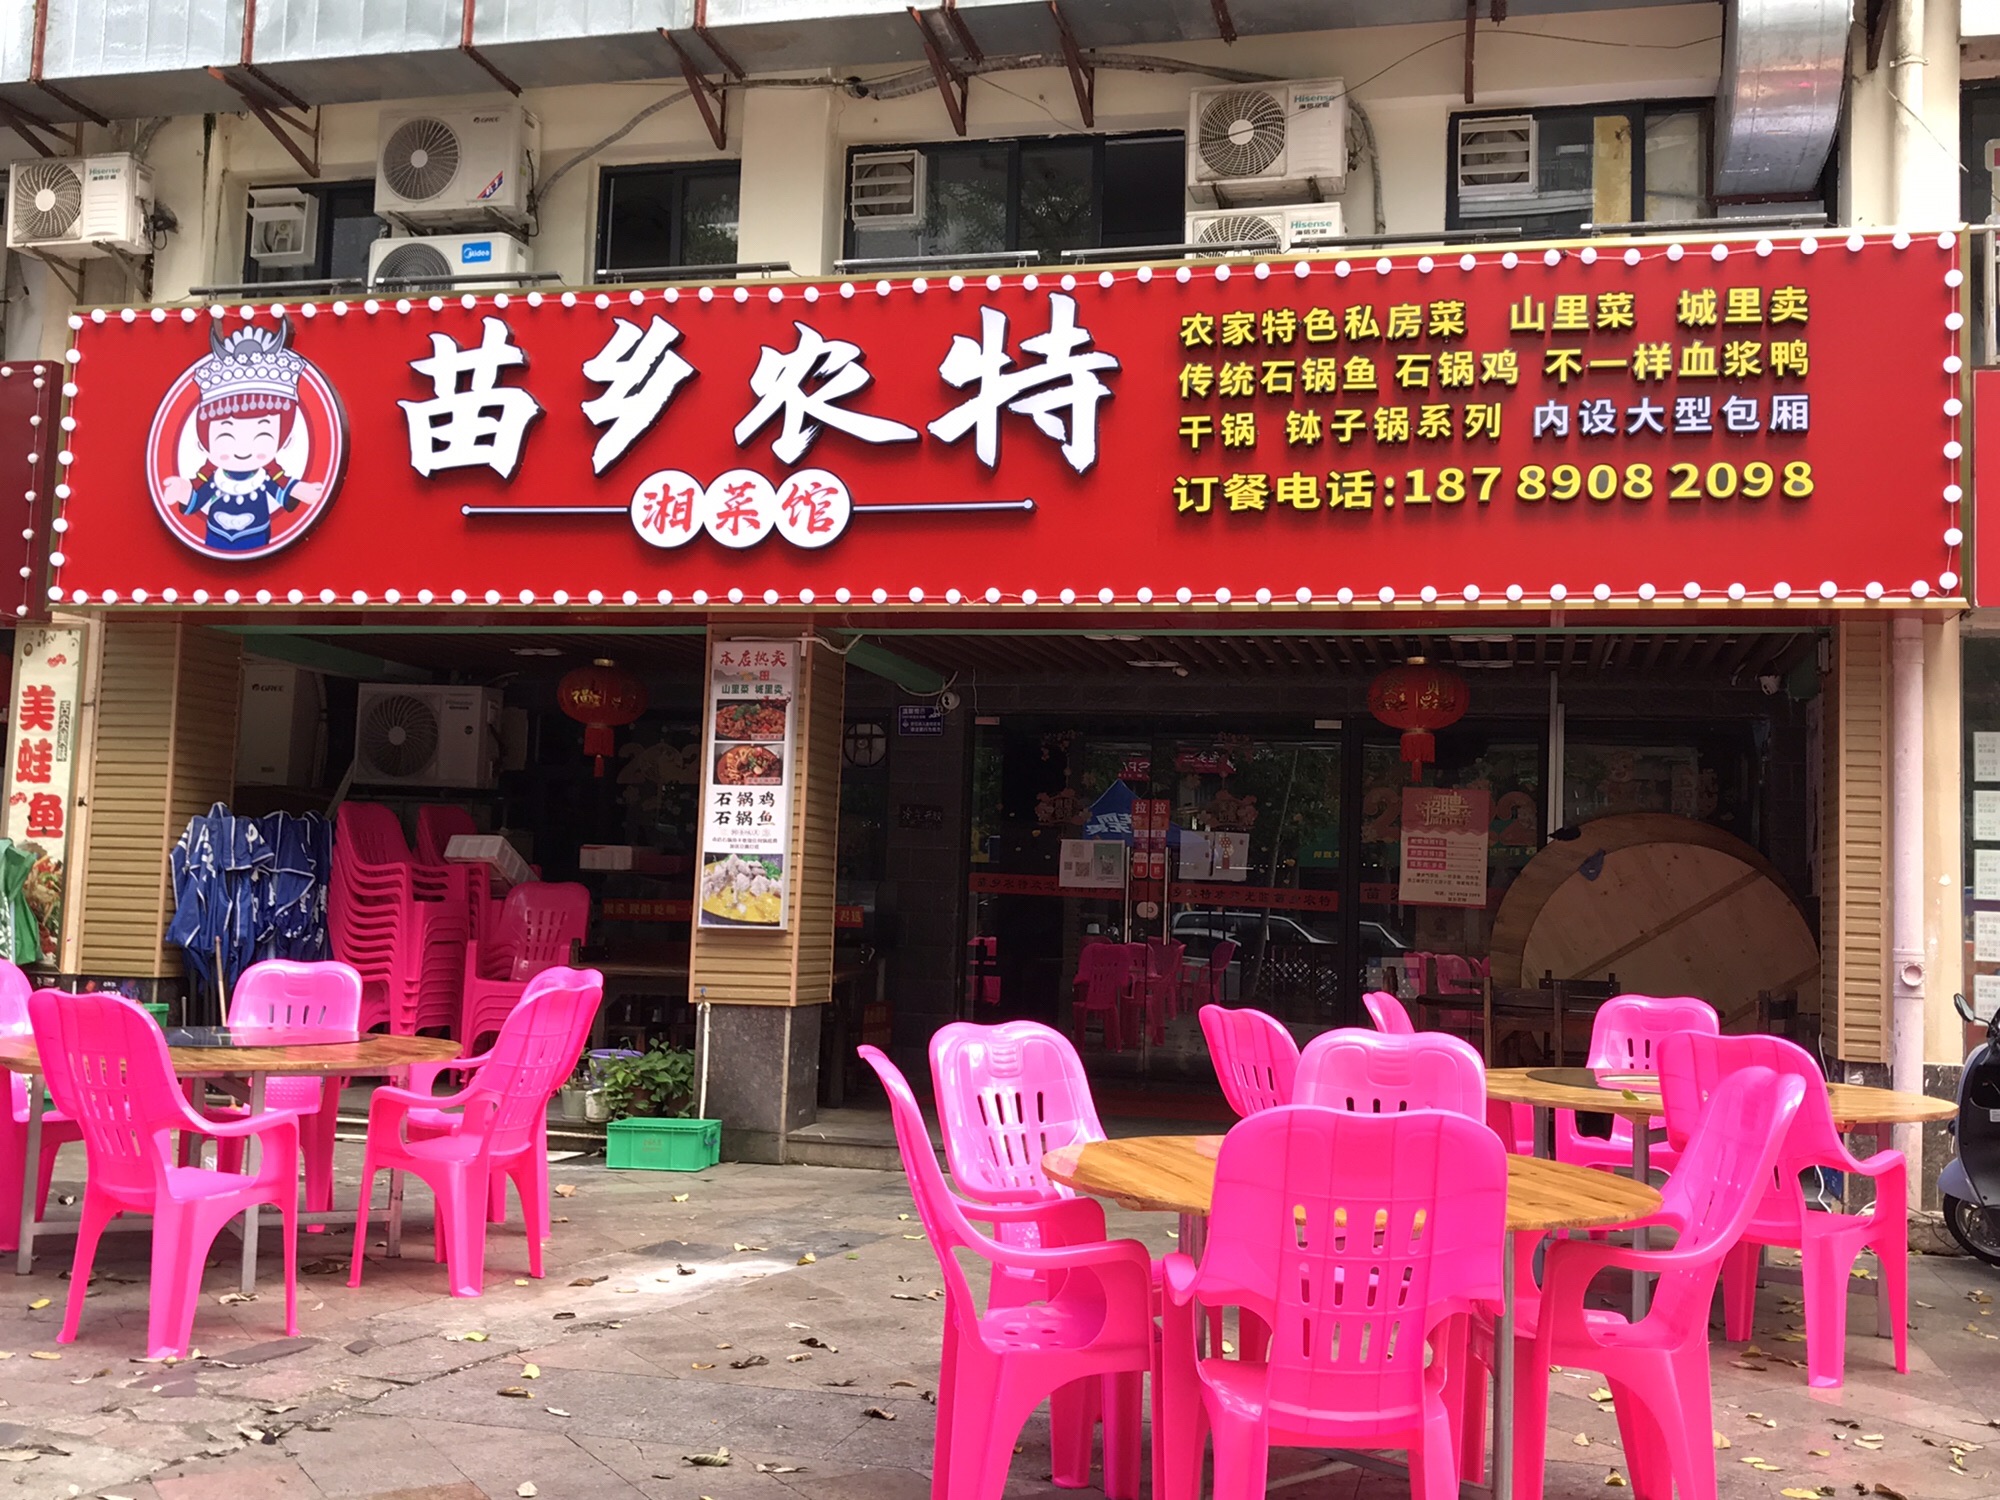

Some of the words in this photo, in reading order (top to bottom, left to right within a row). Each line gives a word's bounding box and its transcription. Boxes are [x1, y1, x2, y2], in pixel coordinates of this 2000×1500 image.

[1294, 94, 1335, 103] Hisense
[1290, 220, 1332, 229] Hisense
[467, 248, 490, 259] Midea
[1180, 300, 1465, 347] 农家特色私房菜
[1510, 292, 1634, 331] 山里菜
[1678, 286, 1809, 326] 城里卖
[1178, 355, 1378, 397] 传统石锅鱼
[1395, 349, 1519, 388] 石锅鸡
[1544, 339, 1810, 383] 不一样血浆鸭
[397, 292, 1121, 479] 苗乡农特
[1178, 412, 1256, 449] 干锅
[1285, 402, 1502, 445] 钵子锅系列
[1533, 394, 1810, 437] 内设大型包厢
[1516, 463, 1654, 501] 8908
[1669, 460, 1815, 499] 2098
[642, 483, 840, 536] 湘菜馆
[719, 649, 788, 668] 本店热卖
[260, 684, 285, 692] GREE
[721, 683, 749, 695] 山里菜
[754, 683, 783, 695] 城里卖
[16, 684, 64, 839] 美蛙鱼
[713, 790, 775, 808] 石锅鸡
[1135, 801, 1147, 814] 拉
[1421, 790, 1470, 826] 招聘
[1154, 802, 1167, 815] 拉
[712, 810, 776, 827] 石锅鱼
